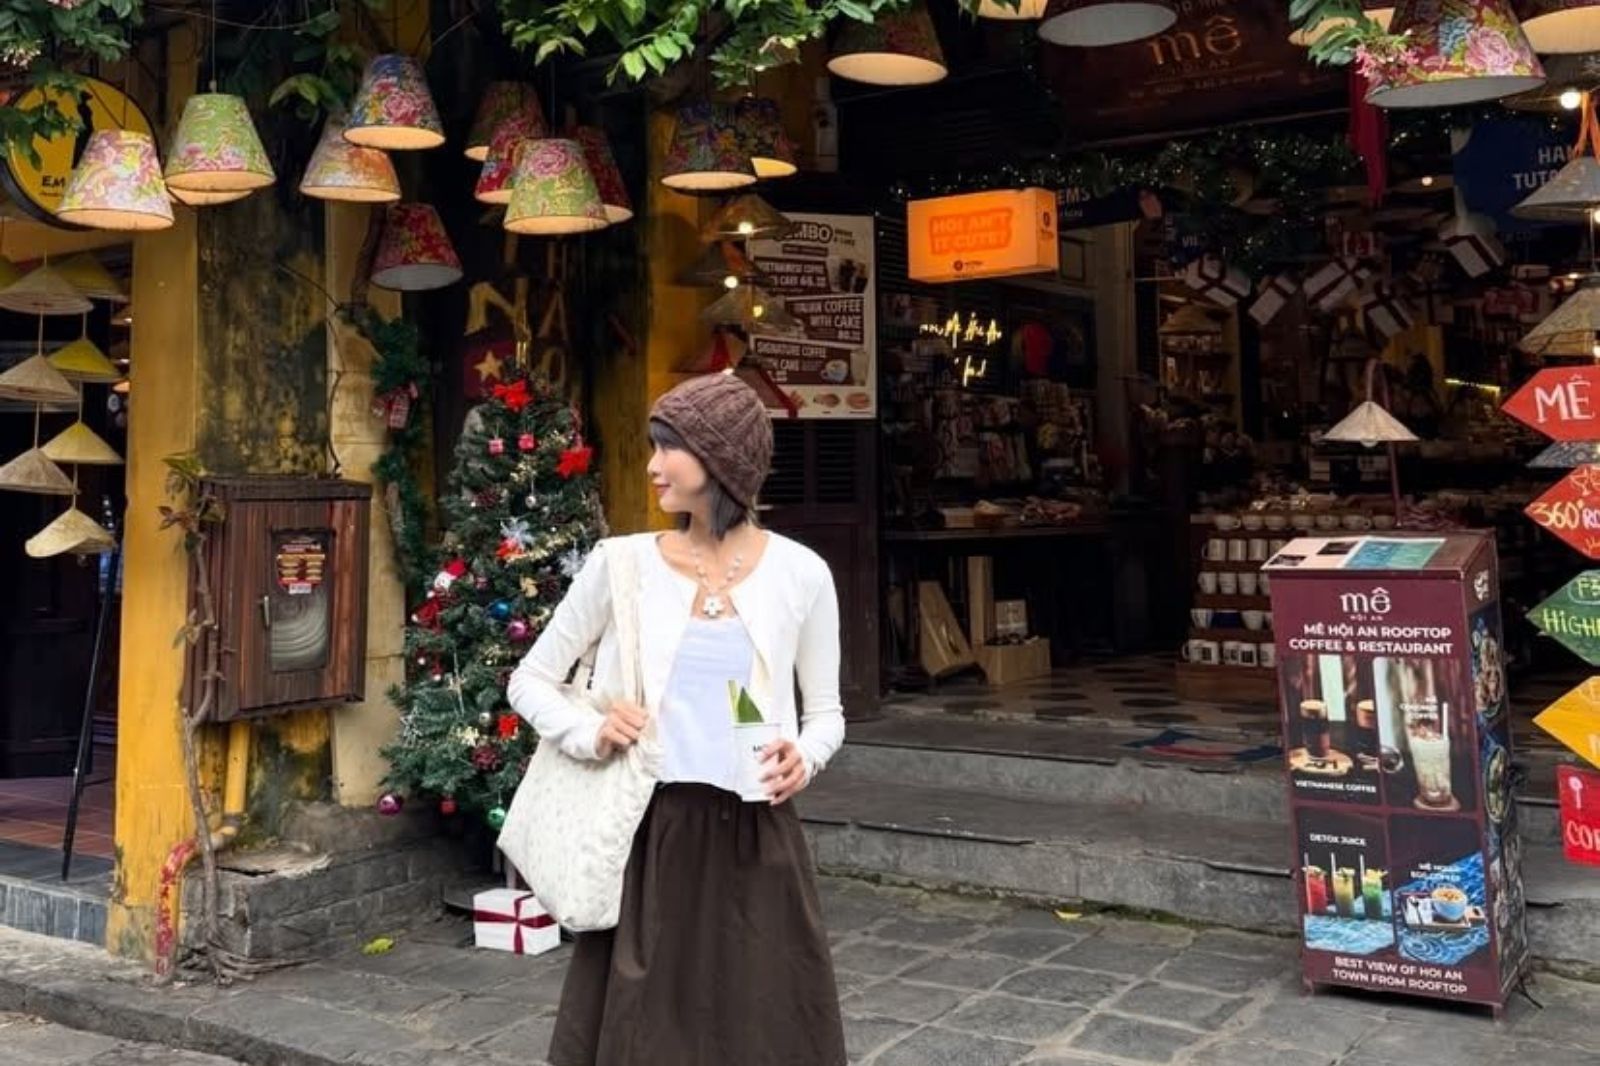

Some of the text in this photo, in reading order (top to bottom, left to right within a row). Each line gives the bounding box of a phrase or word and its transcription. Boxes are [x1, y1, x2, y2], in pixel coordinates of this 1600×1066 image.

[823, 299, 862, 314] COFFEE
[834, 315, 861, 329] CAKE
[1534, 373, 1595, 424] MÊ
[1339, 586, 1392, 614] mê
[1303, 621, 1452, 639] MÊ HỘI AN ROOFTOP
[1288, 638, 1454, 654] COFFEE & RESTAURANT
[1295, 780, 1377, 793] VIETNAMESE COFFEE
[1310, 833, 1366, 846] DETOX JUICE
[1335, 956, 1364, 969] BEST
[1366, 960, 1398, 973] VIEW
[1400, 964, 1417, 975] OF
[1445, 971, 1463, 980] AN
[1332, 968, 1468, 994] TOWN FROM ROOFTOP
